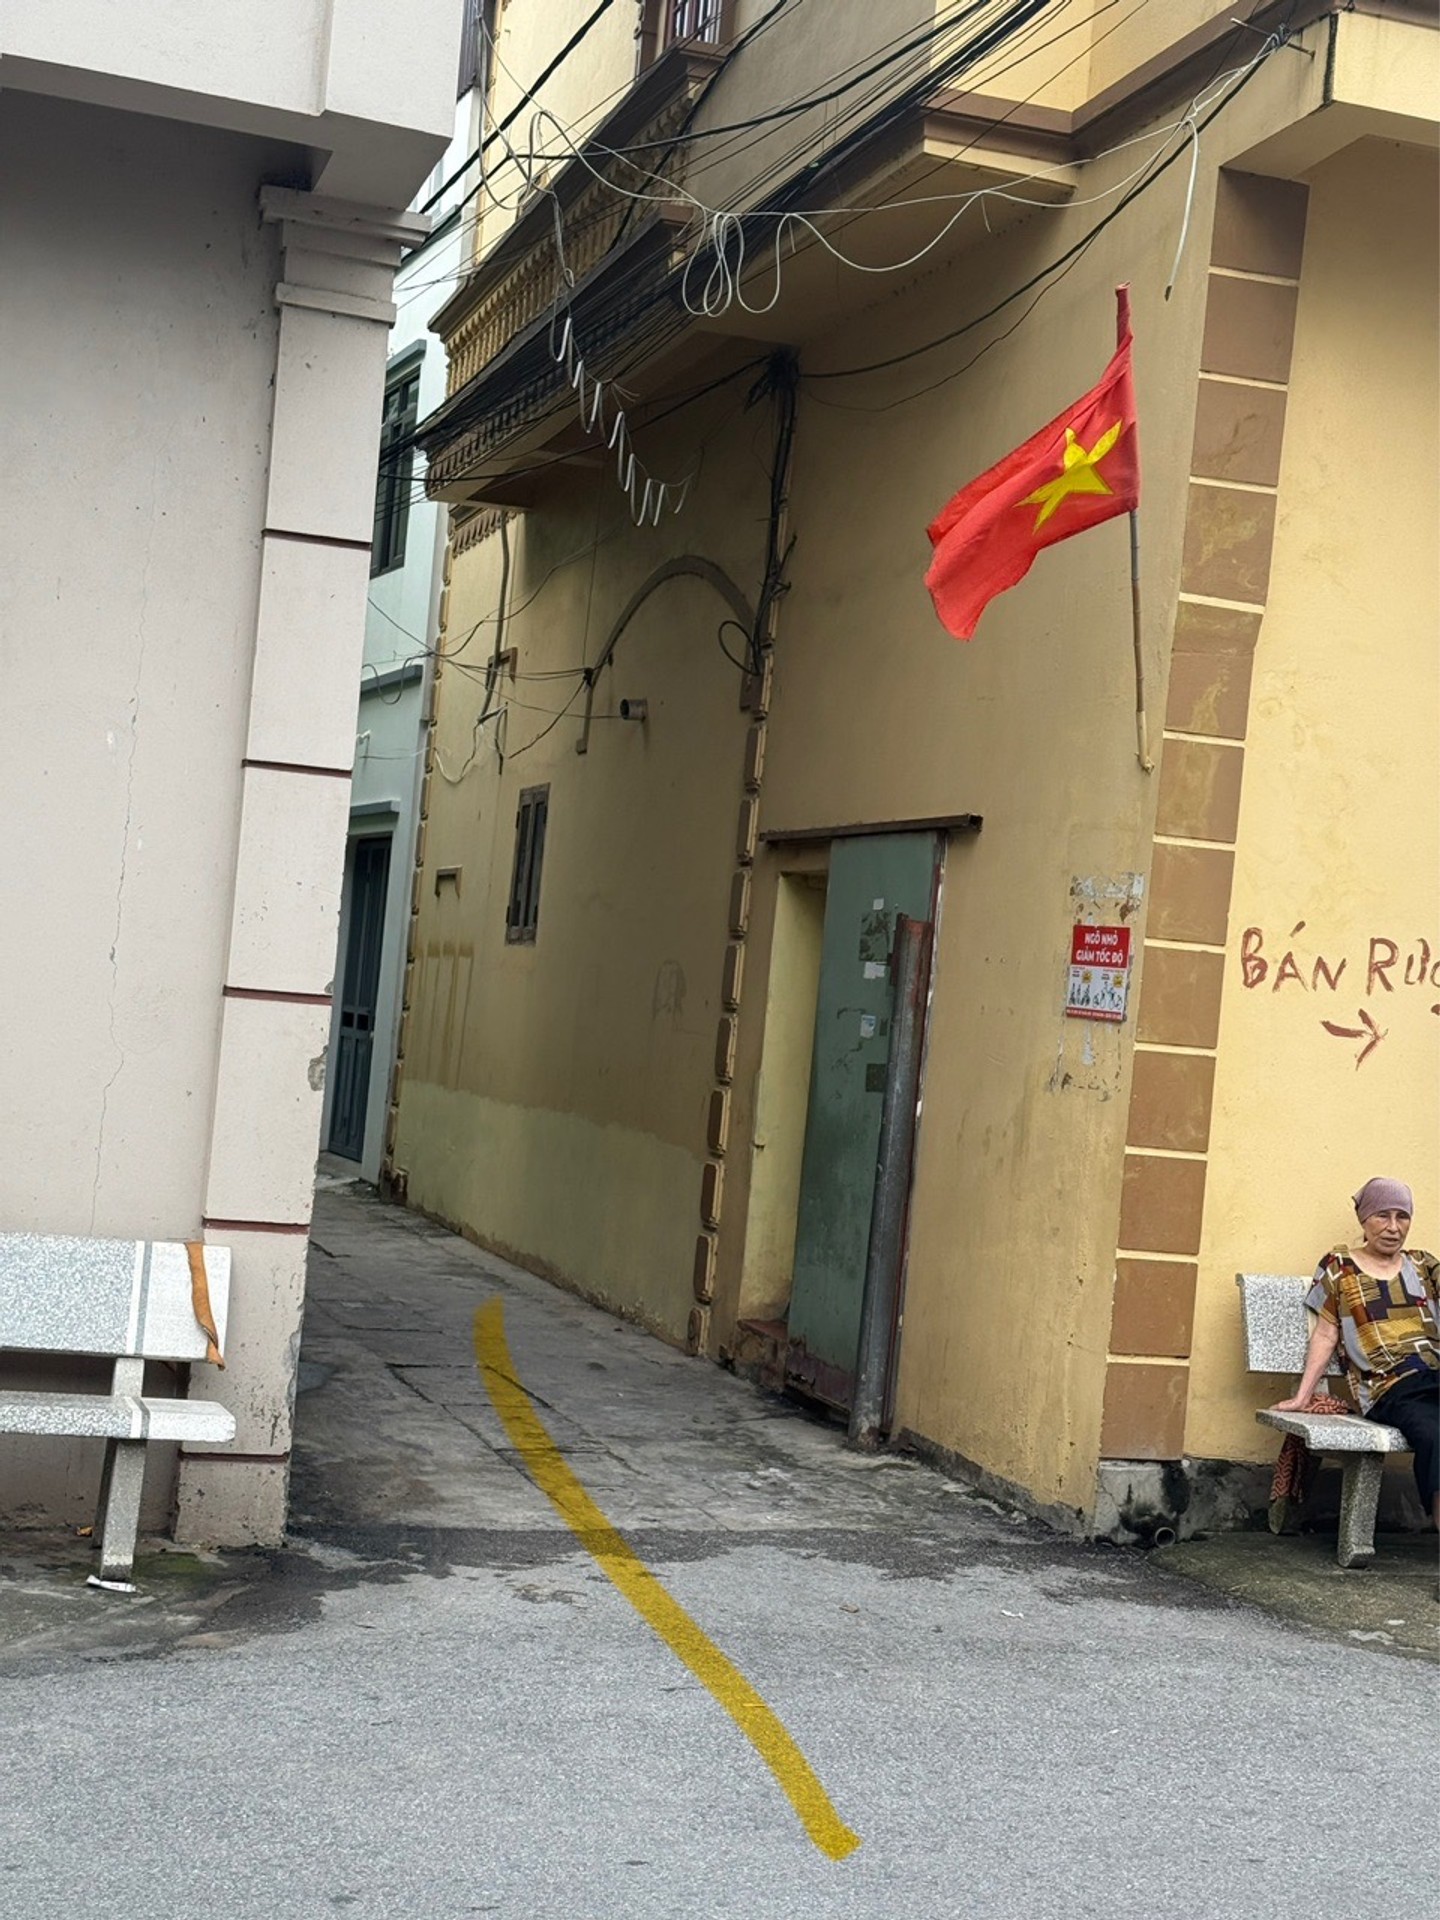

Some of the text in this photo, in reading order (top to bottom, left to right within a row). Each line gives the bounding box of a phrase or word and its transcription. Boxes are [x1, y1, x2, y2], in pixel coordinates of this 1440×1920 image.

[1084, 930, 1118, 946] NGÕ NHỎ
[1076, 946, 1123, 967] GIẢM TỐC ĐỘ
[1240, 920, 1348, 994] BÁN
